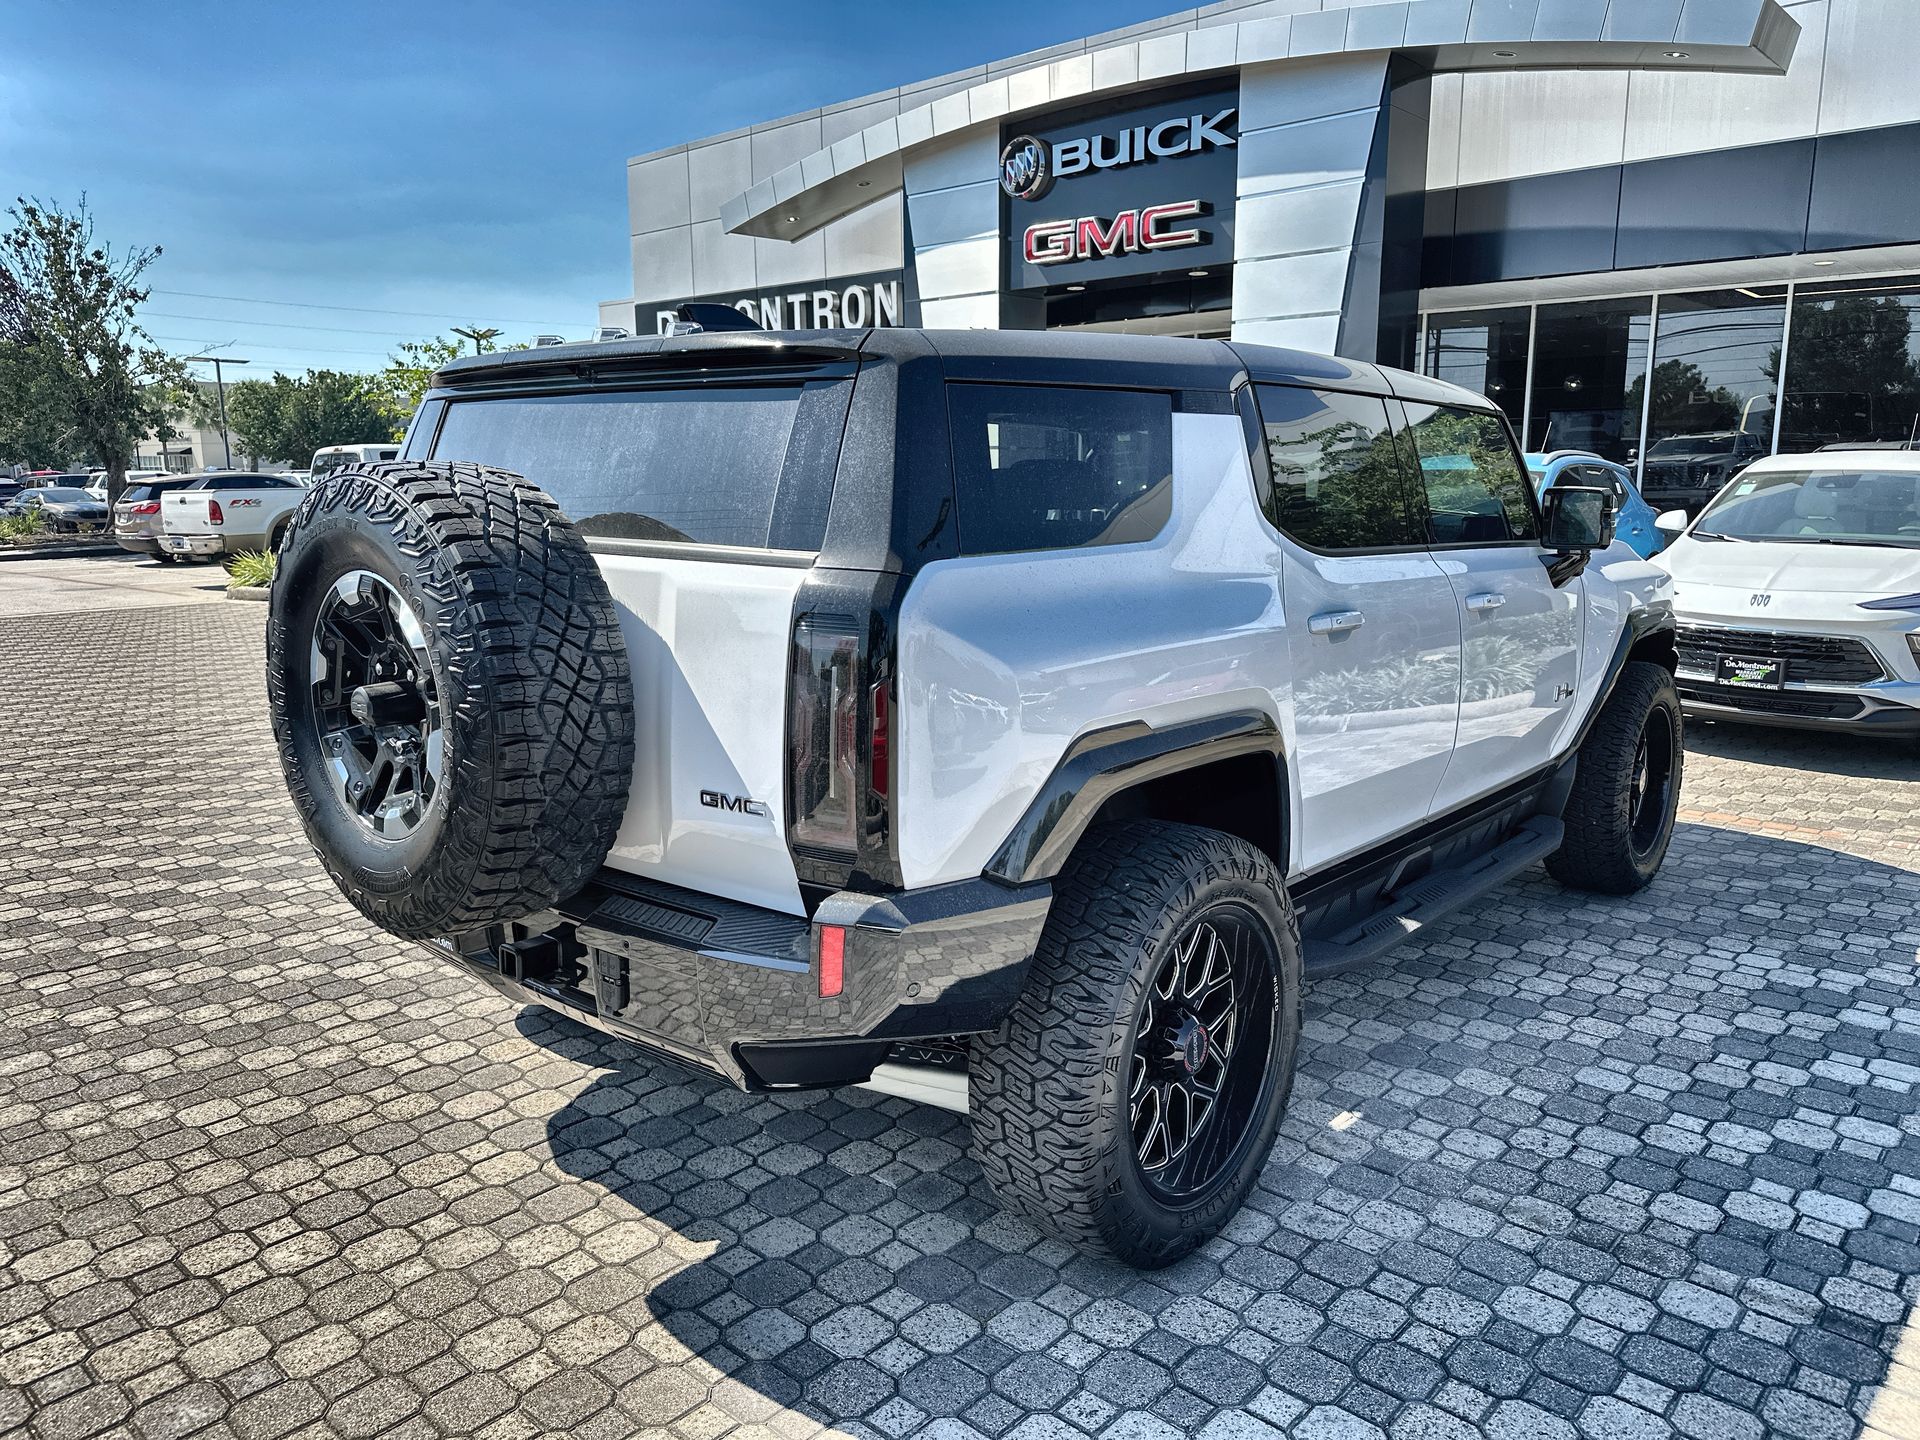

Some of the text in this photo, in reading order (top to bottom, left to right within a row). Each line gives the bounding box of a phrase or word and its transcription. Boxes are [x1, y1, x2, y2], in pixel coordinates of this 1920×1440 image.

[1052, 108, 1236, 177] BUICK
[1023, 200, 1201, 264] GMC
[656, 280, 898, 335] DNTRON
[700, 790, 766, 817] GMC
